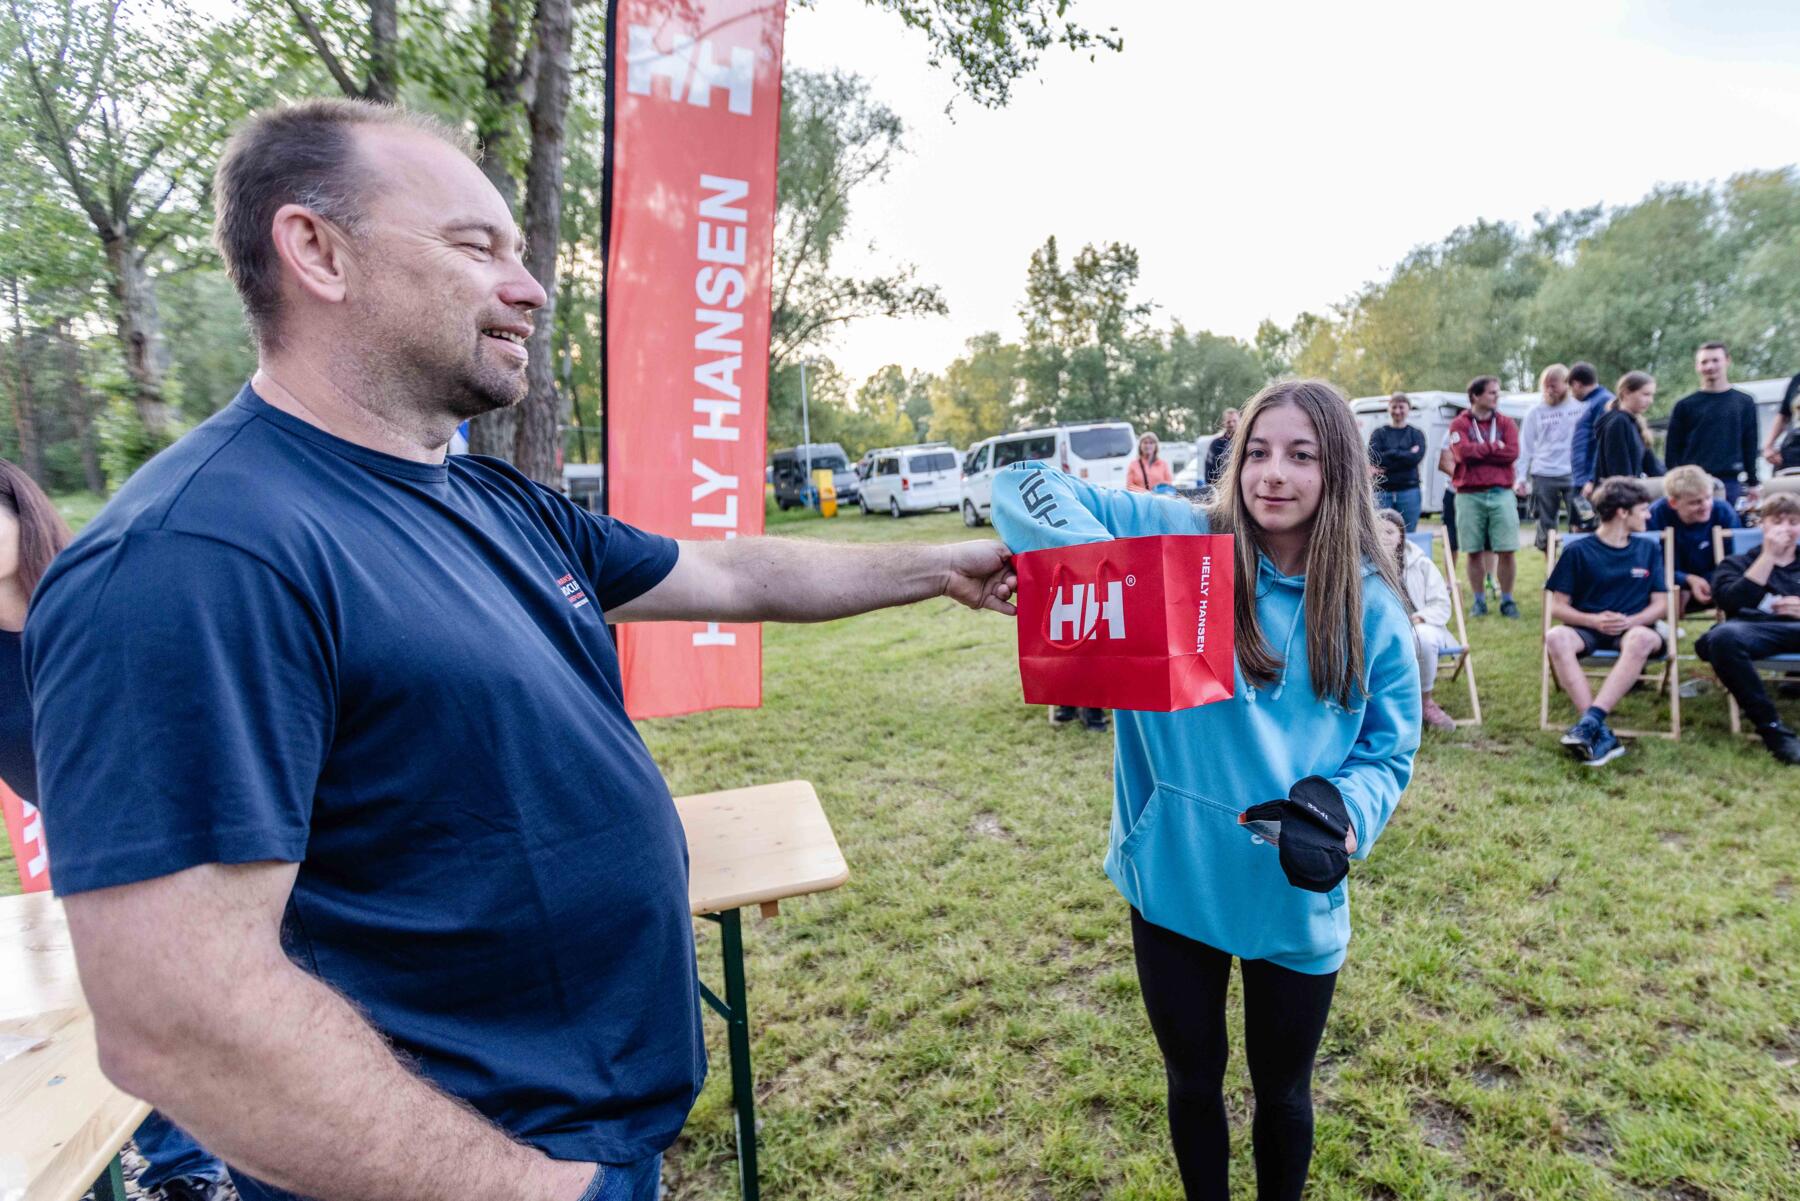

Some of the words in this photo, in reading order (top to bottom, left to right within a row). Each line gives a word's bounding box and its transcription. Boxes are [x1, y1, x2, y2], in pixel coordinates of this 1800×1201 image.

[692, 174, 751, 441] HANSEN
[691, 461, 740, 647] HLY
[1200, 556, 1211, 596] HELLY
[1196, 600, 1208, 653] HANSEN
